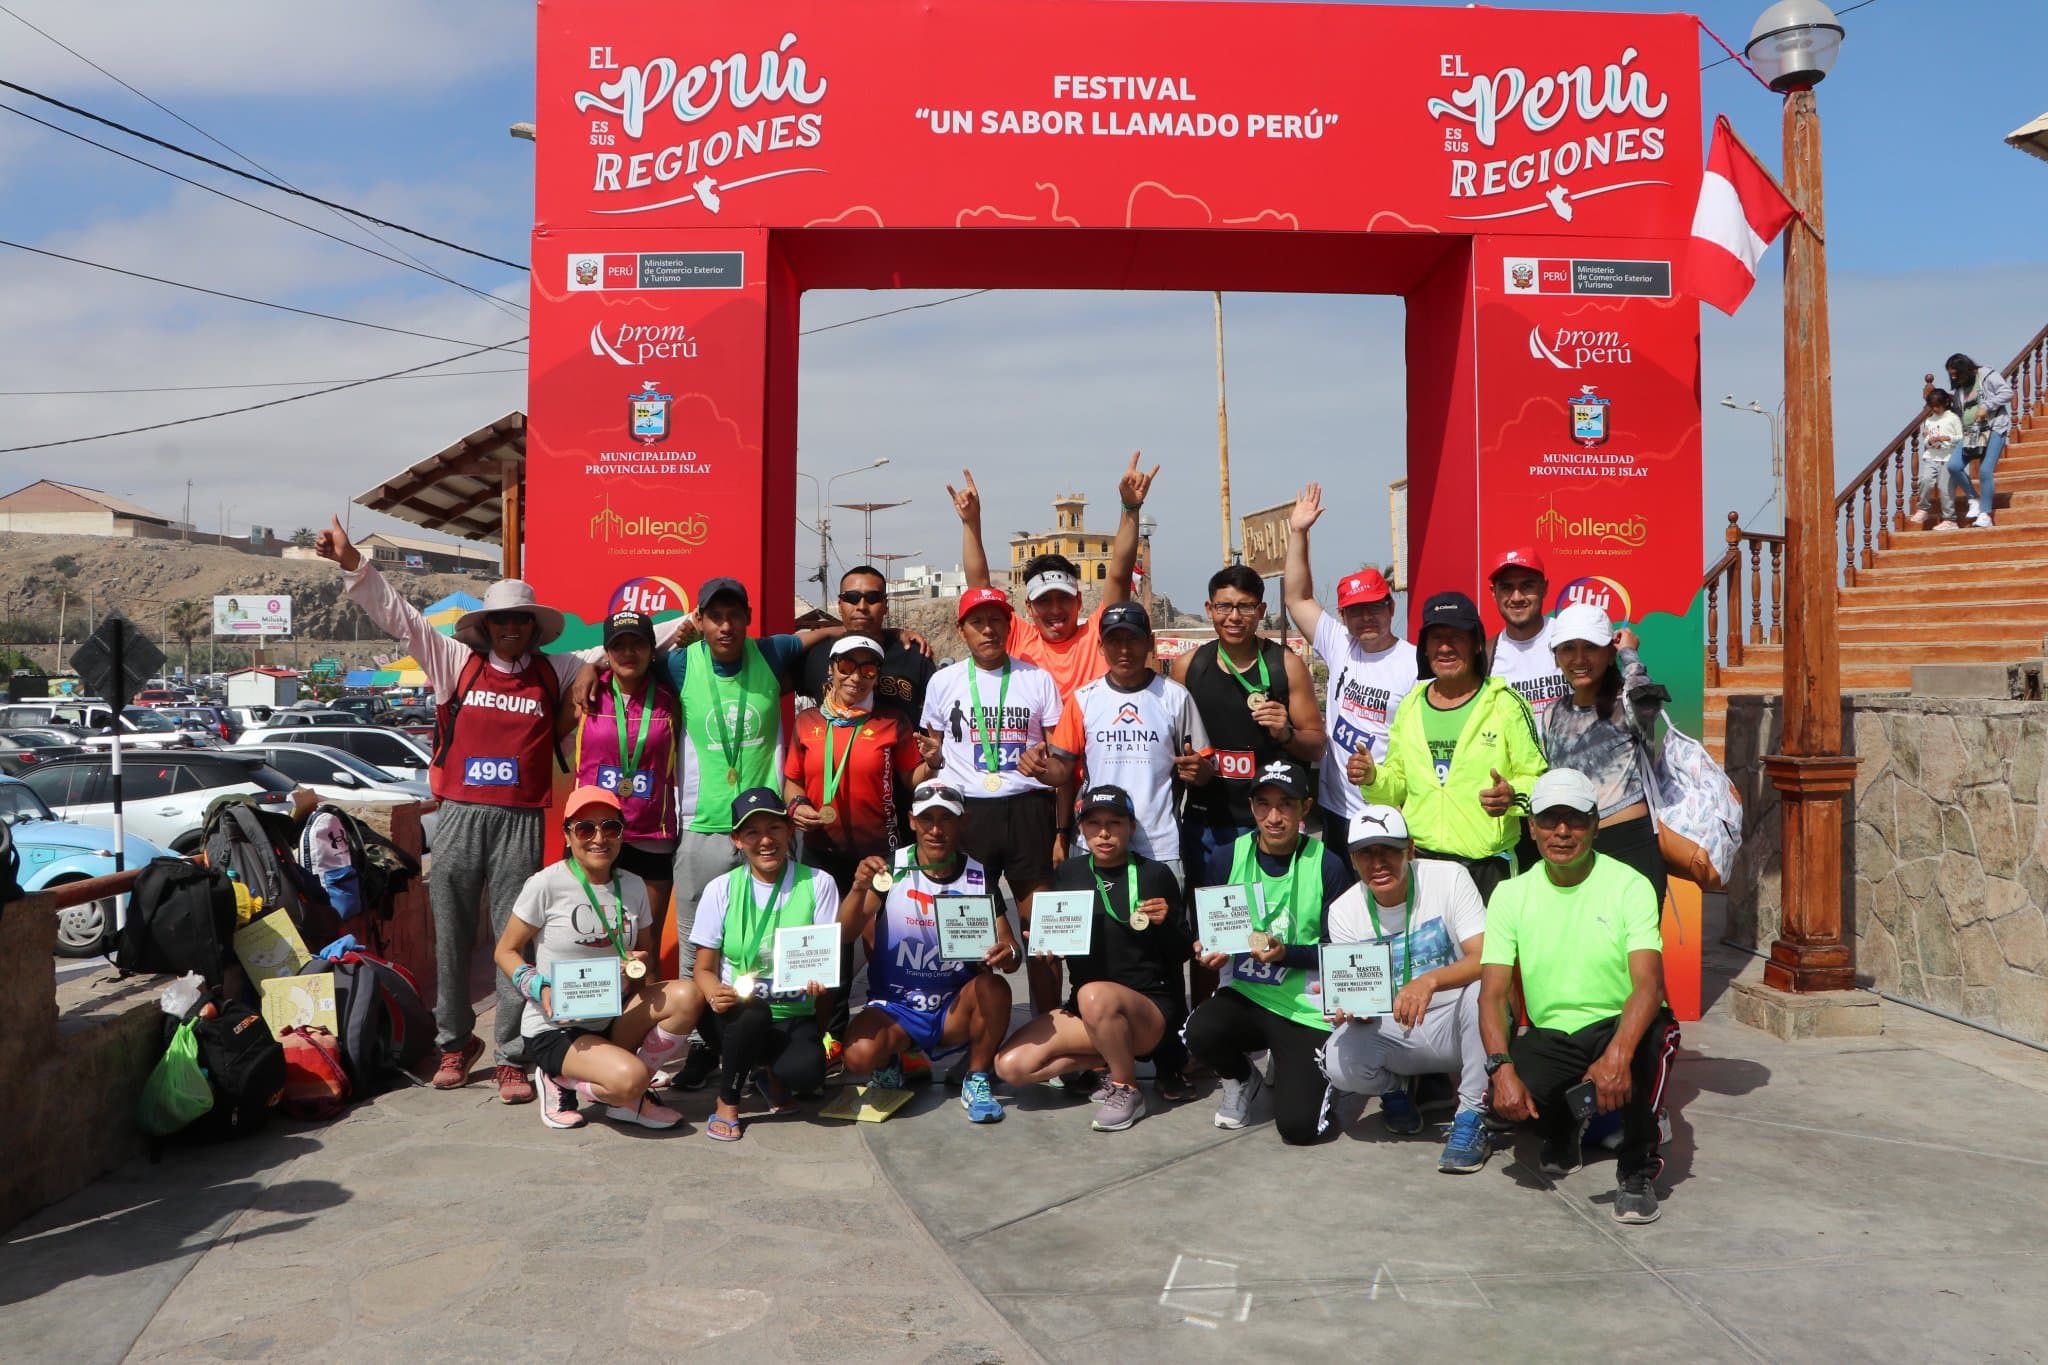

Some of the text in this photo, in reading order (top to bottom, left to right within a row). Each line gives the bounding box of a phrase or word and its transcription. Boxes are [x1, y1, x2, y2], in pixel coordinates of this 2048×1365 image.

[589, 46, 619, 69] EL
[1440, 54, 1469, 77] EL
[574, 32, 827, 138] Perú
[1053, 75, 1196, 101] FESTIVAL
[1427, 47, 1668, 146] Perú
[591, 121, 609, 133] ES
[980, 110, 1084, 135] SABOR
[1092, 112, 1239, 137] LLAMADO
[590, 134, 615, 146] SUS
[1445, 128, 1462, 139] ES
[593, 114, 823, 192] REGIONES
[1444, 141, 1469, 153] SUS
[1449, 127, 1665, 198] REGIONES
[644, 259, 684, 267] Ministerio
[608, 264, 633, 276] PERÚ
[644, 266, 724, 275] de Comercio Exterior
[1543, 269, 1567, 281] PERÚ
[1577, 266, 1615, 274] Ministerio
[650, 274, 681, 282] Turismo
[1577, 273, 1653, 283] de Comercio Exterior
[1583, 281, 1613, 290] Turismo
[614, 323, 685, 349] prom
[1552, 327, 1619, 352] prom
[635, 336, 698, 365] perú
[1574, 342, 1632, 369] perú
[599, 451, 696, 462] MUNICIPALIDAD
[1543, 453, 1634, 464] MUNICIPALIDAD
[585, 463, 712, 474] PROVINCIAL DE ISLAY
[1529, 466, 1649, 477] PROVINCIAL DE ISLAY
[1547, 684, 1570, 699] CON
[463, 690, 544, 717] AREQUIPA
[1366, 697, 1387, 711] CON
[970, 717, 1029, 729] CRRE CON
[1096, 730, 1160, 743] CHILINA
[1106, 744, 1149, 752] TRAIL
[468, 761, 513, 781] 496
[1259, 771, 1292, 784] adidas
[602, 770, 647, 793] 36
